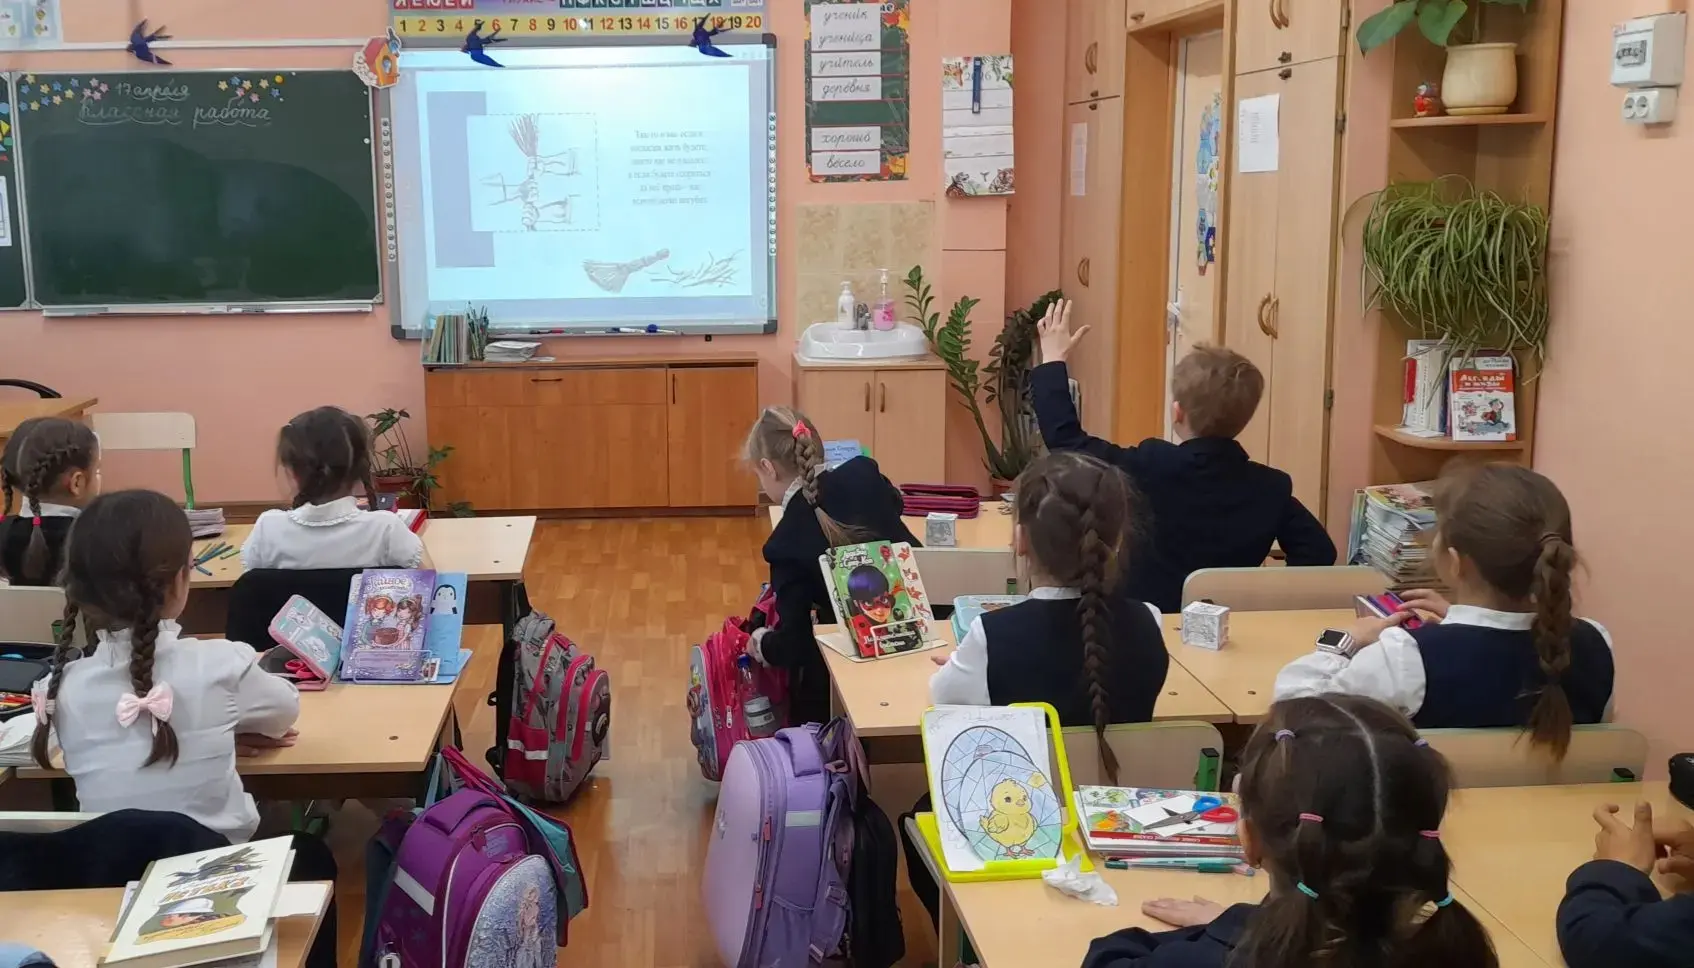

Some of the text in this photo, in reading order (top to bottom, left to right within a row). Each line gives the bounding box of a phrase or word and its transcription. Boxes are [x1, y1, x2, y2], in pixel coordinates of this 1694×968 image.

[399, 19, 407, 32] 1
[418, 19, 427, 32] 2
[437, 19, 445, 32] 3
[455, 19, 463, 32] 4
[492, 18, 501, 32] 6
[510, 18, 518, 31] 7
[529, 18, 537, 31] 8
[547, 18, 555, 31] 9
[564, 18, 577, 31] 10
[600, 17, 614, 30] 12
[618, 17, 633, 30] 13
[637, 17, 651, 30] 14
[655, 17, 669, 30] 15
[673, 17, 688, 30] 16
[727, 16, 742, 29] 19
[745, 16, 762, 29] 20
